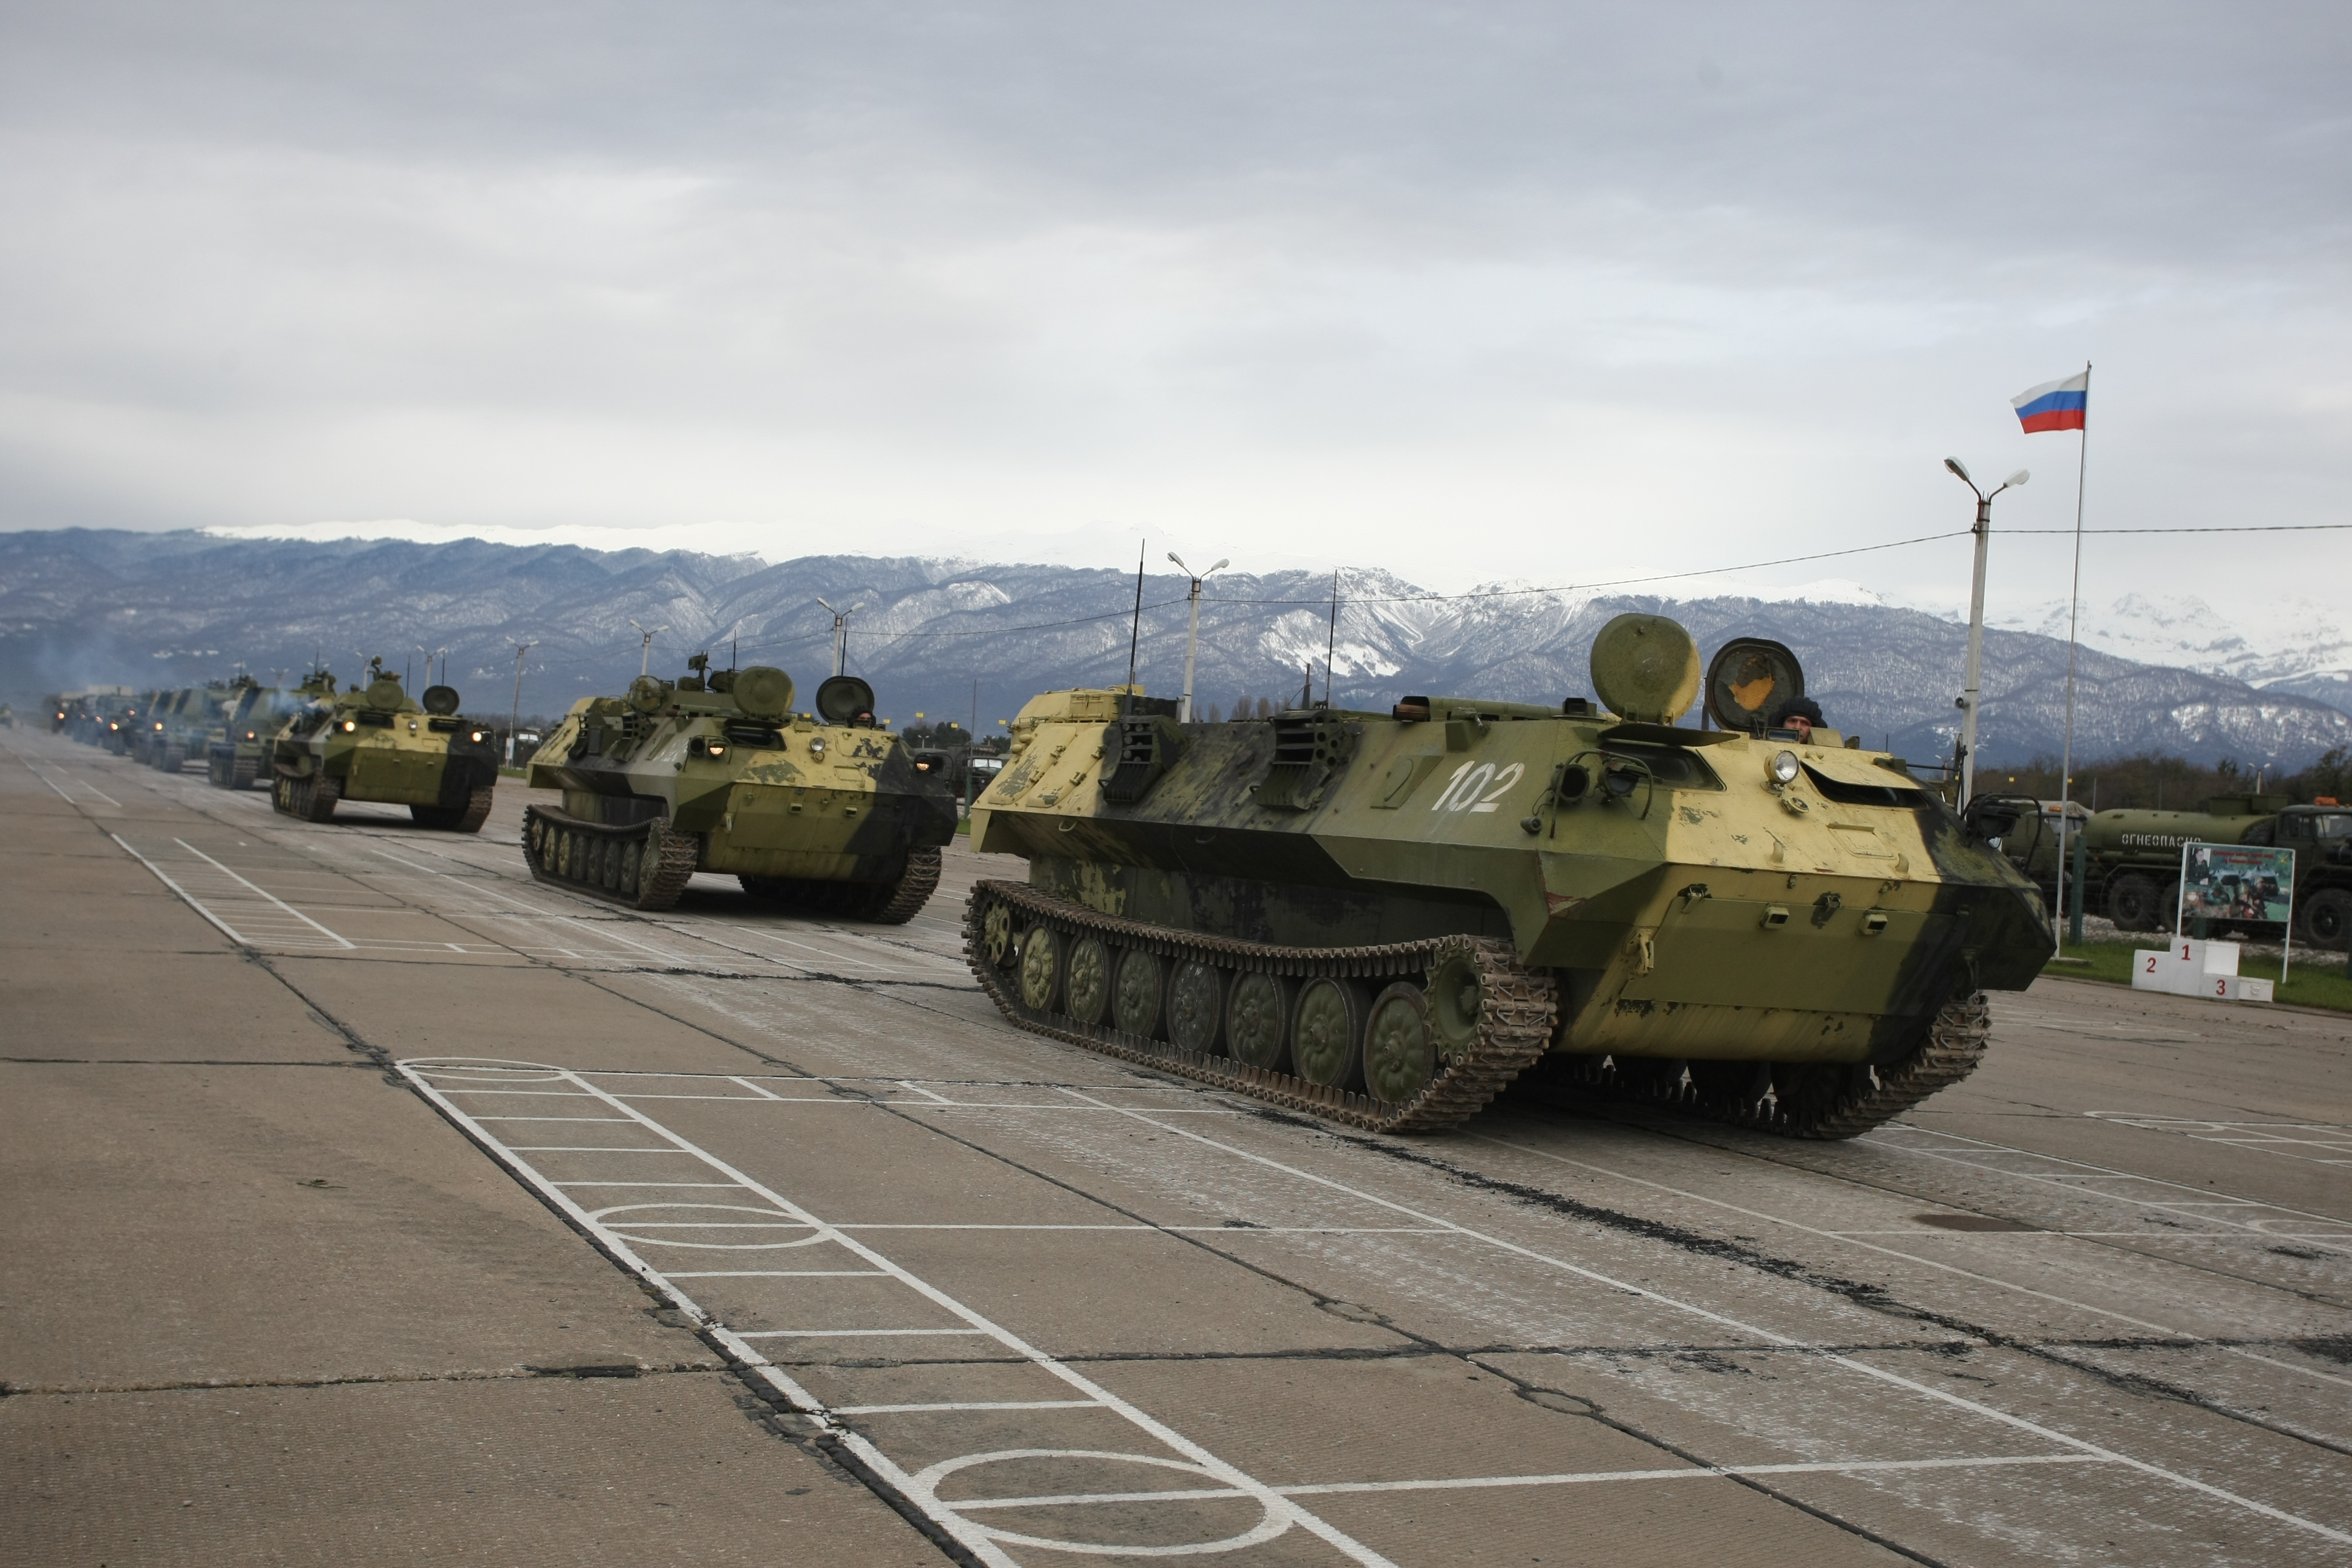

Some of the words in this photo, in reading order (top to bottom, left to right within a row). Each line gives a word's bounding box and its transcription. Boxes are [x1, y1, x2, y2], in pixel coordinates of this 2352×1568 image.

[1431, 760, 1525, 812] 102
[2181, 945, 2190, 960] 1
[2146, 958, 2156, 973] 2
[2216, 980, 2226, 995] 3
